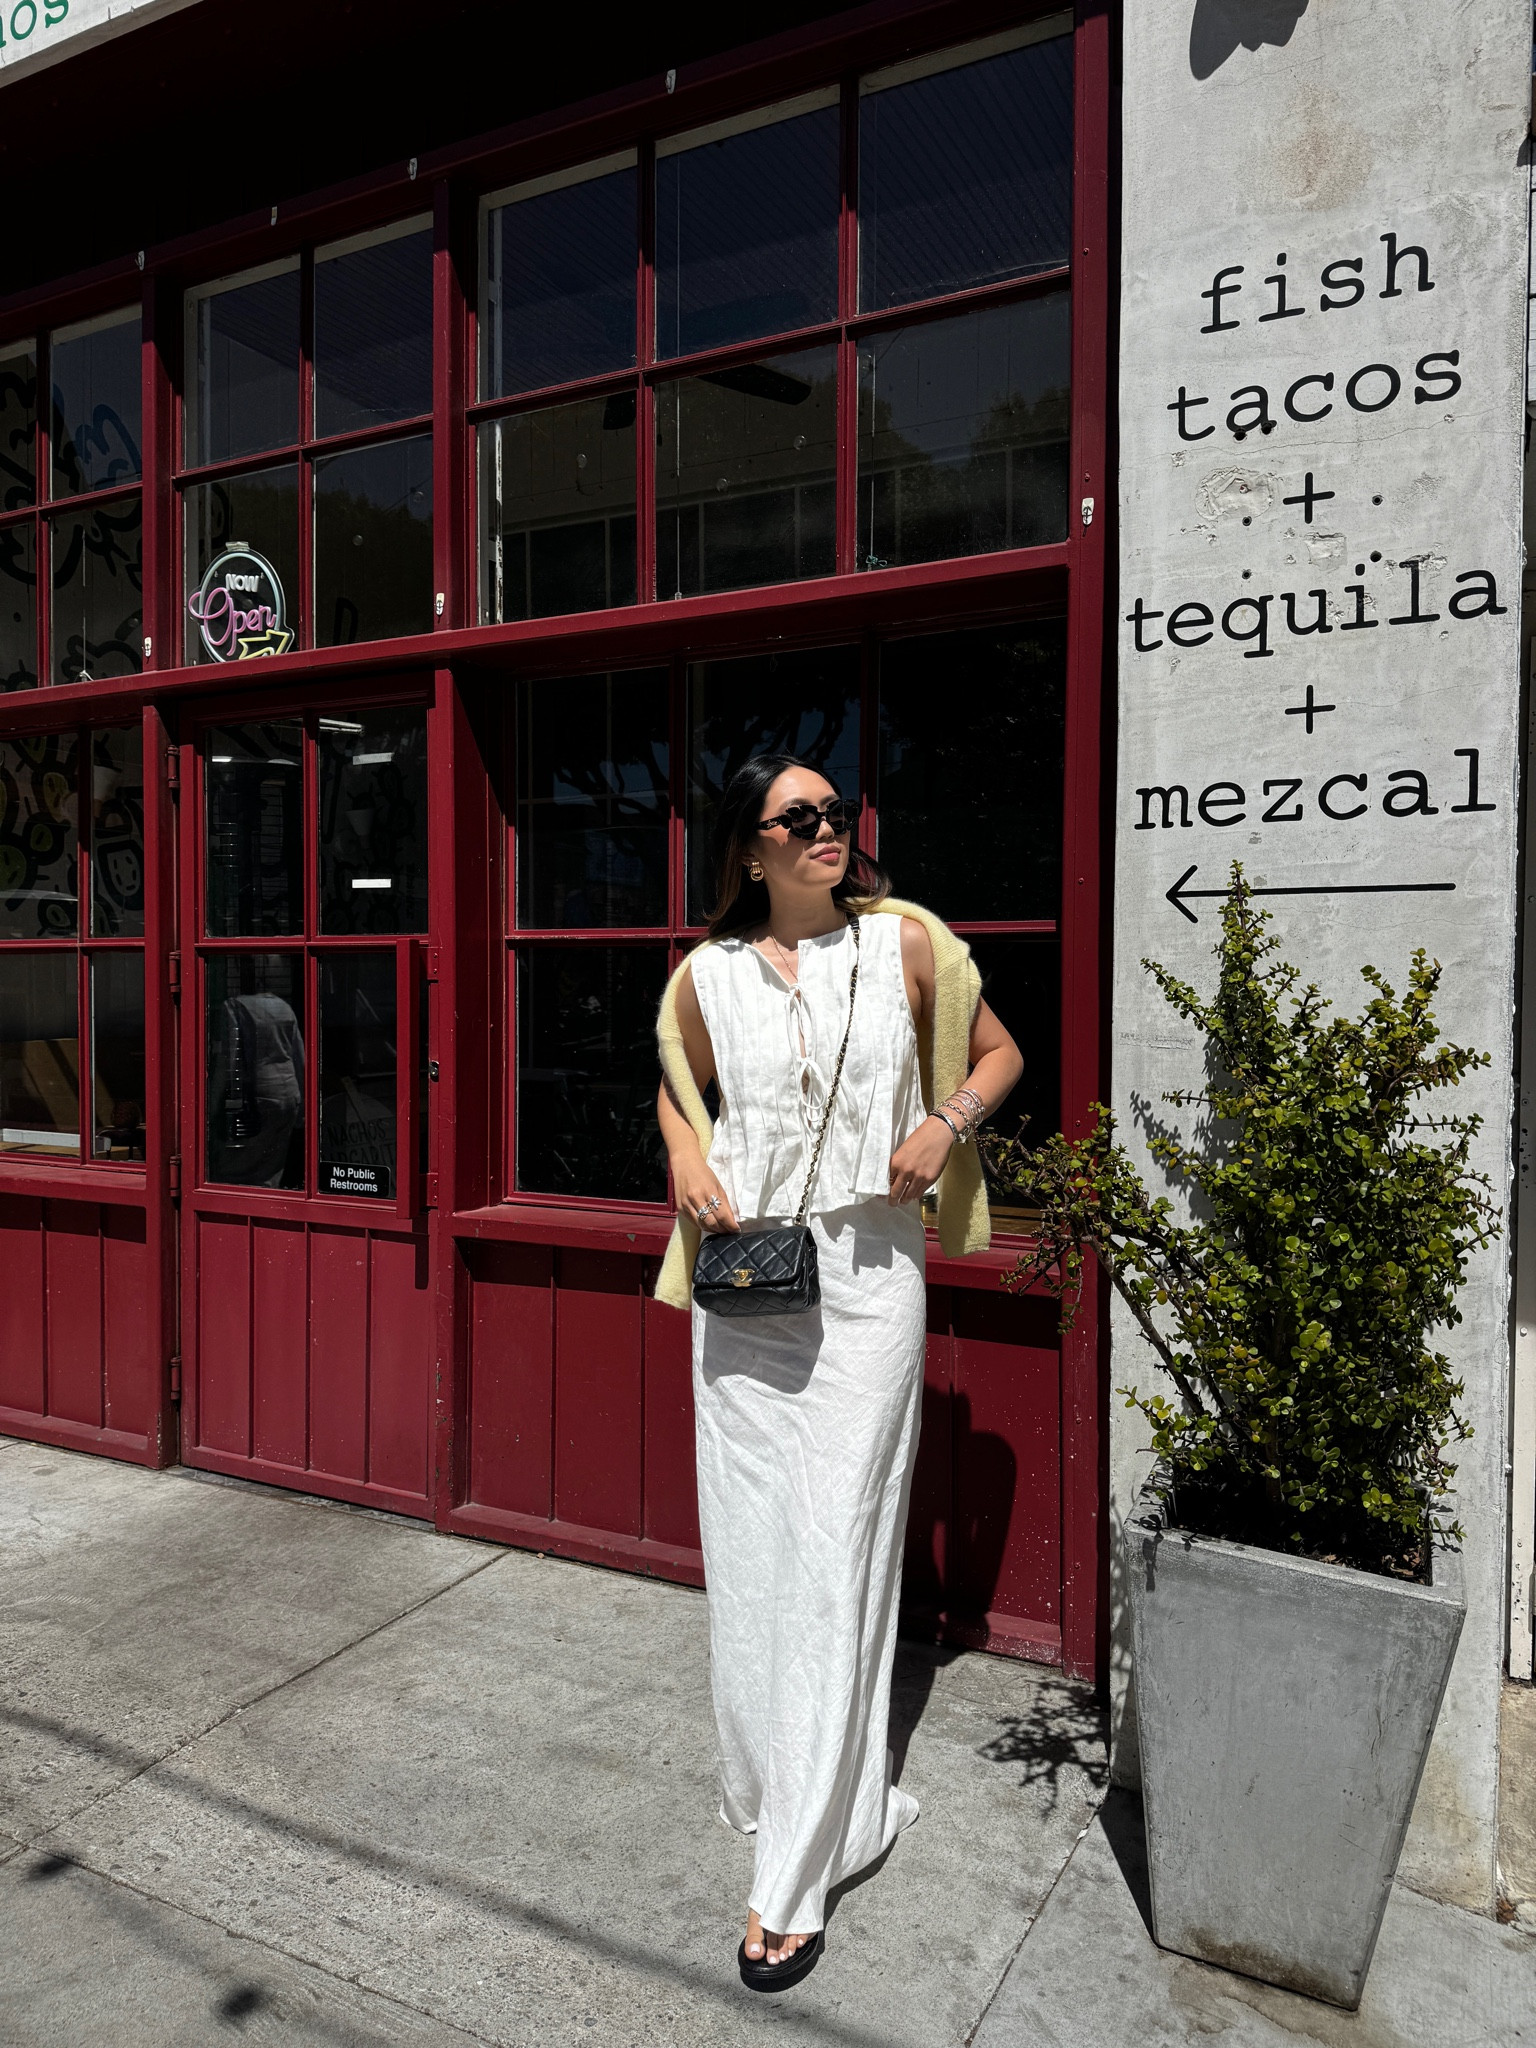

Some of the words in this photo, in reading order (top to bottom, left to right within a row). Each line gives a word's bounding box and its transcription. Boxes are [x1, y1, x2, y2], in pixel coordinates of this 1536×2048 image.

[0, 0, 69, 48] os
[1200, 232, 1436, 334] fish
[1166, 349, 1462, 442] tacos
[1282, 471, 1336, 525] +
[225, 573, 259, 592] NOW
[1125, 558, 1508, 659] tequila
[188, 587, 277, 656] Open
[1284, 684, 1336, 735] +
[1134, 748, 1497, 830] mezcal
[326, 1118, 387, 1147] NACHOS
[329, 1178, 379, 1193] Restrooms
[332, 1166, 346, 1178] No
[347, 1167, 376, 1180] Public
